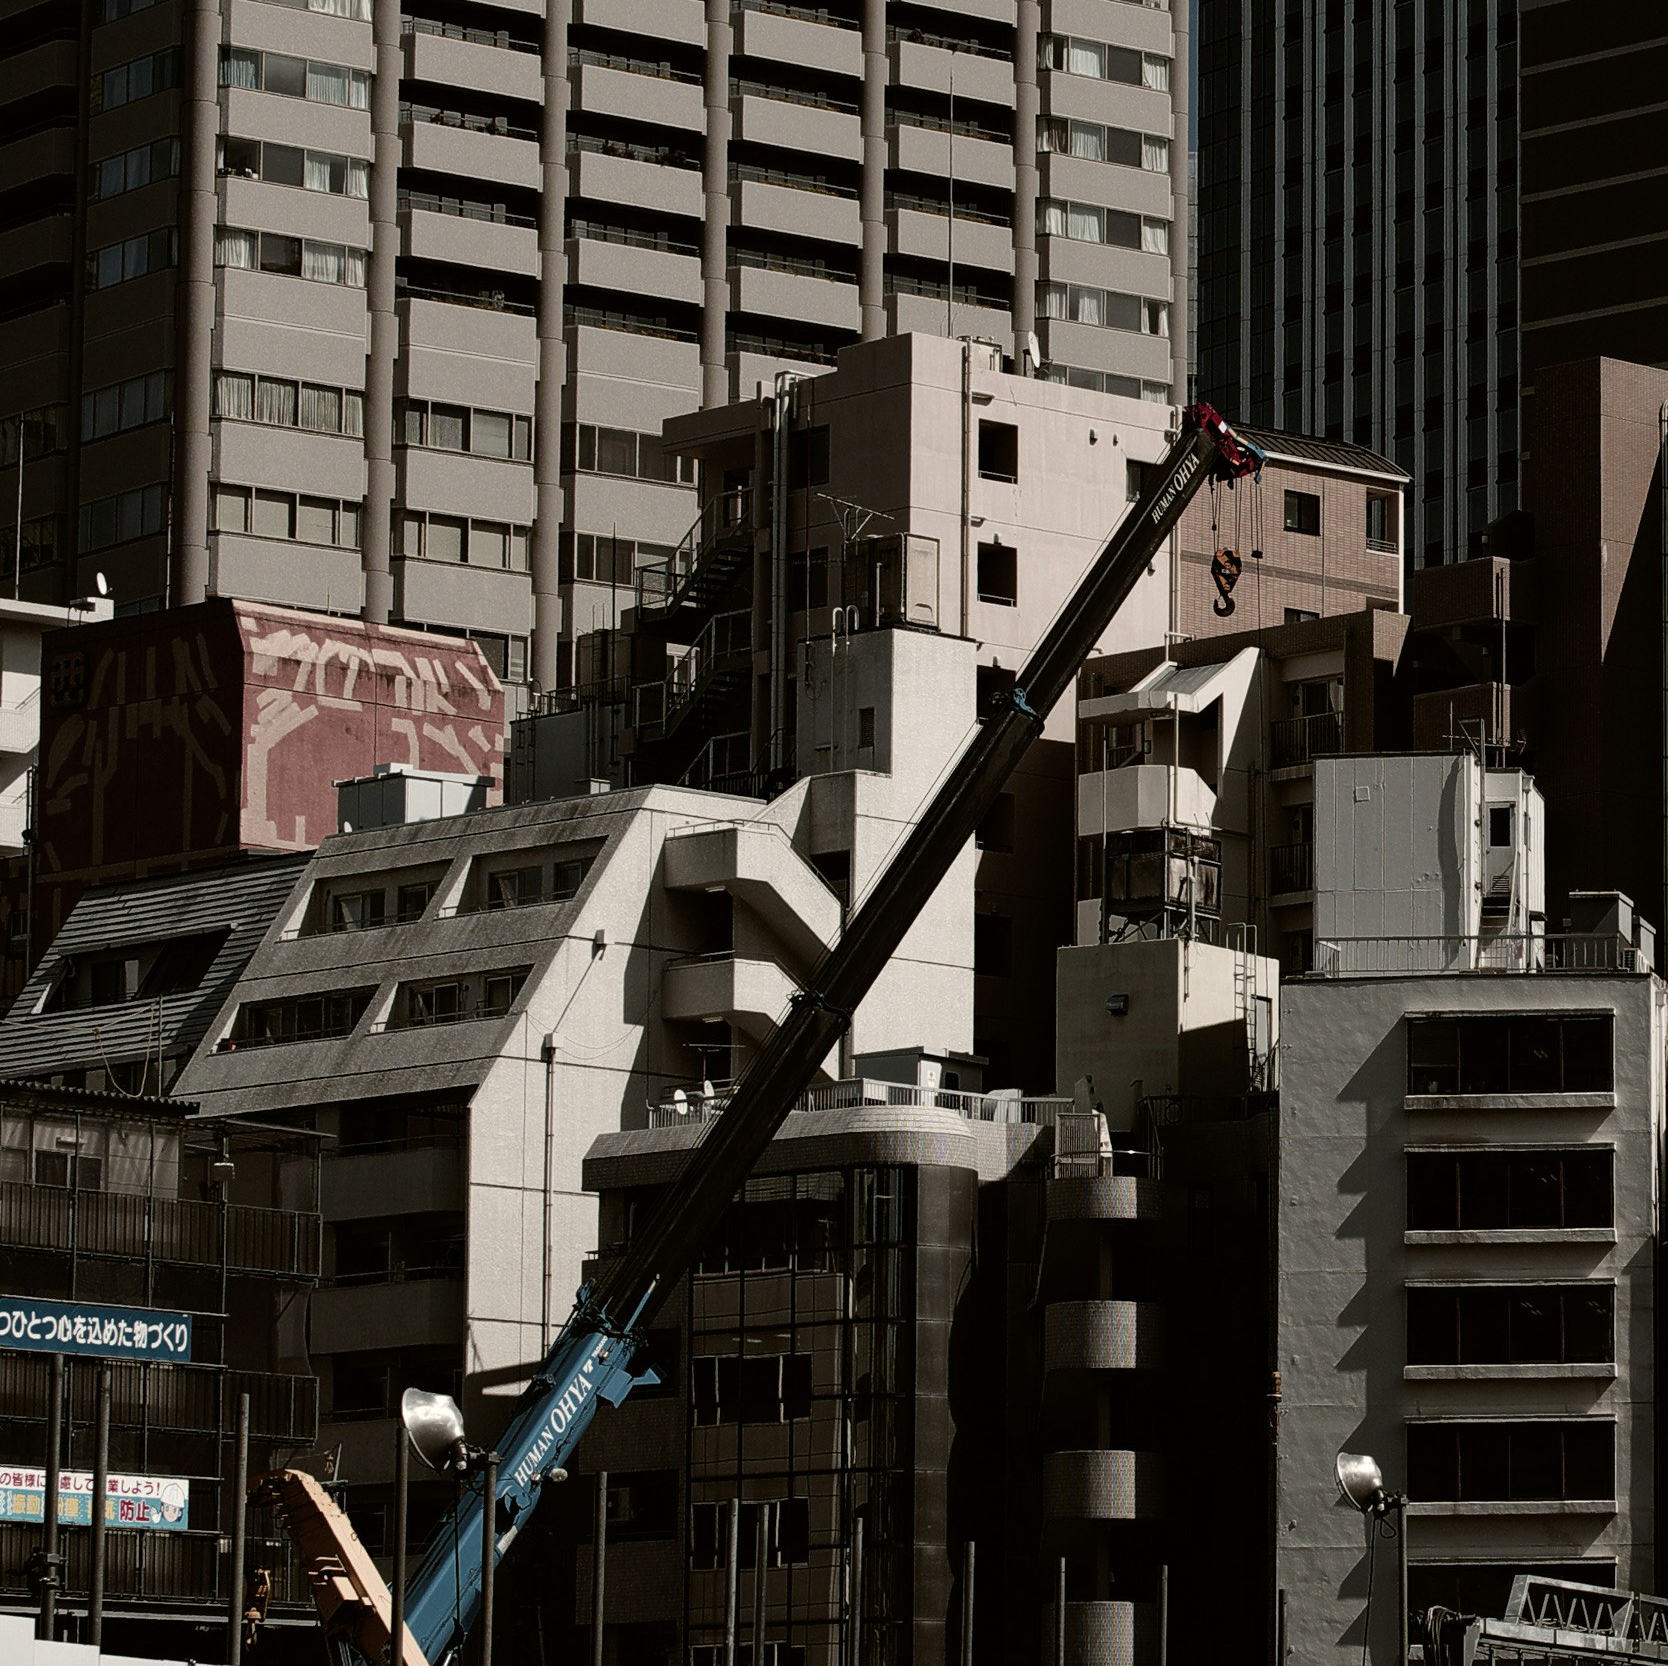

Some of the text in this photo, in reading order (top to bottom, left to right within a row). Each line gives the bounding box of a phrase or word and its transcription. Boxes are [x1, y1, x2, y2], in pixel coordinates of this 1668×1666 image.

[1151, 452, 1200, 525] HUMAN OHYA
[513, 1373, 593, 1487] HUMAN OHYA
[1, 1472, 161, 1496] の皆様に慮して業しよう!
[119, 1499, 150, 1522] 防止
